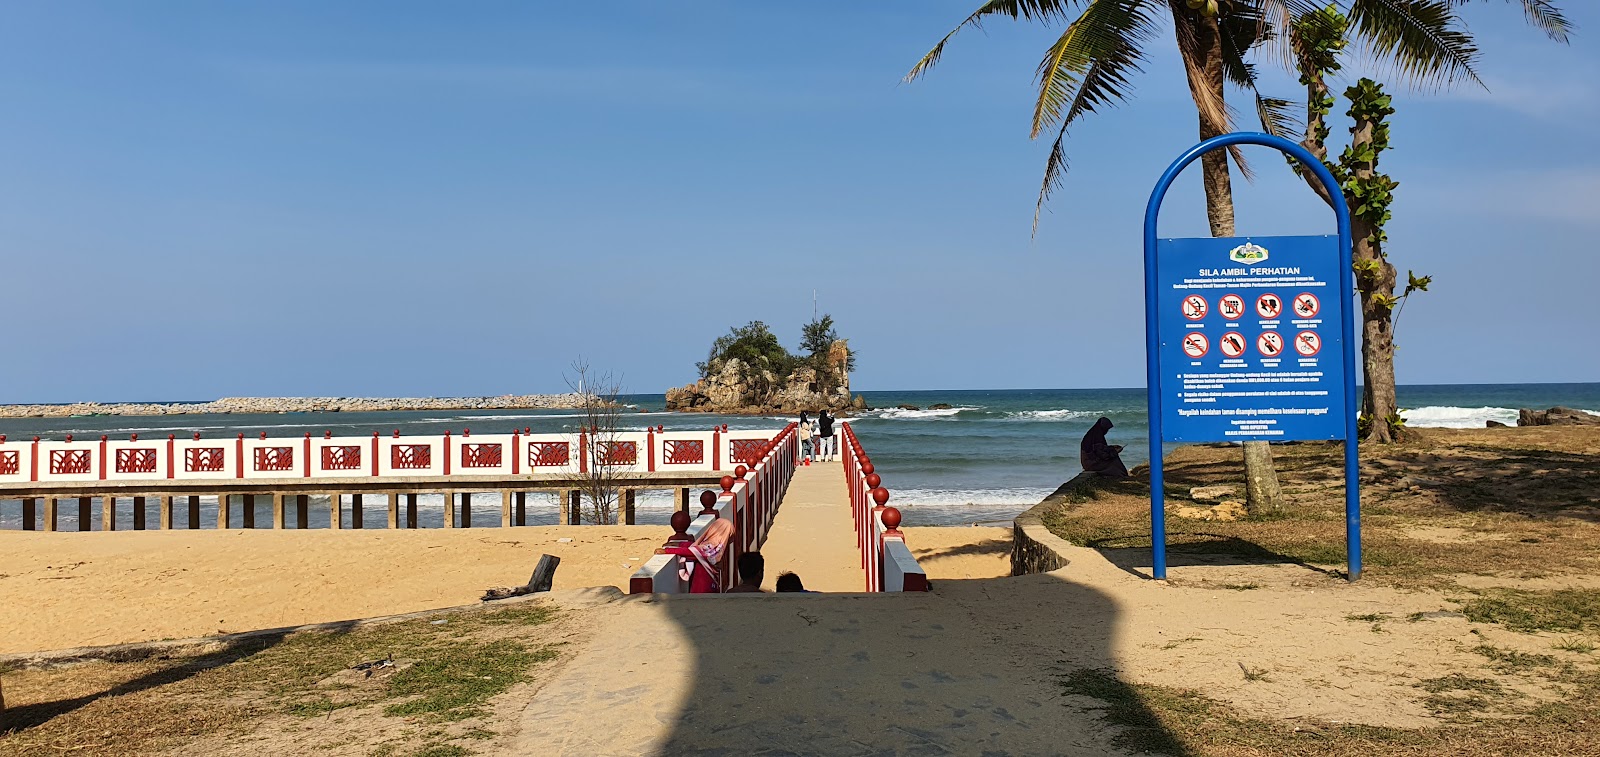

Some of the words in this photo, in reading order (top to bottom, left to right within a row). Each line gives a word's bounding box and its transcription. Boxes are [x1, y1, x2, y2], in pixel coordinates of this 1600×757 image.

[1199, 268, 1219, 276] SILA
[1220, 268, 1248, 276] AMBIL
[1250, 267, 1300, 276] PERHATIAN
